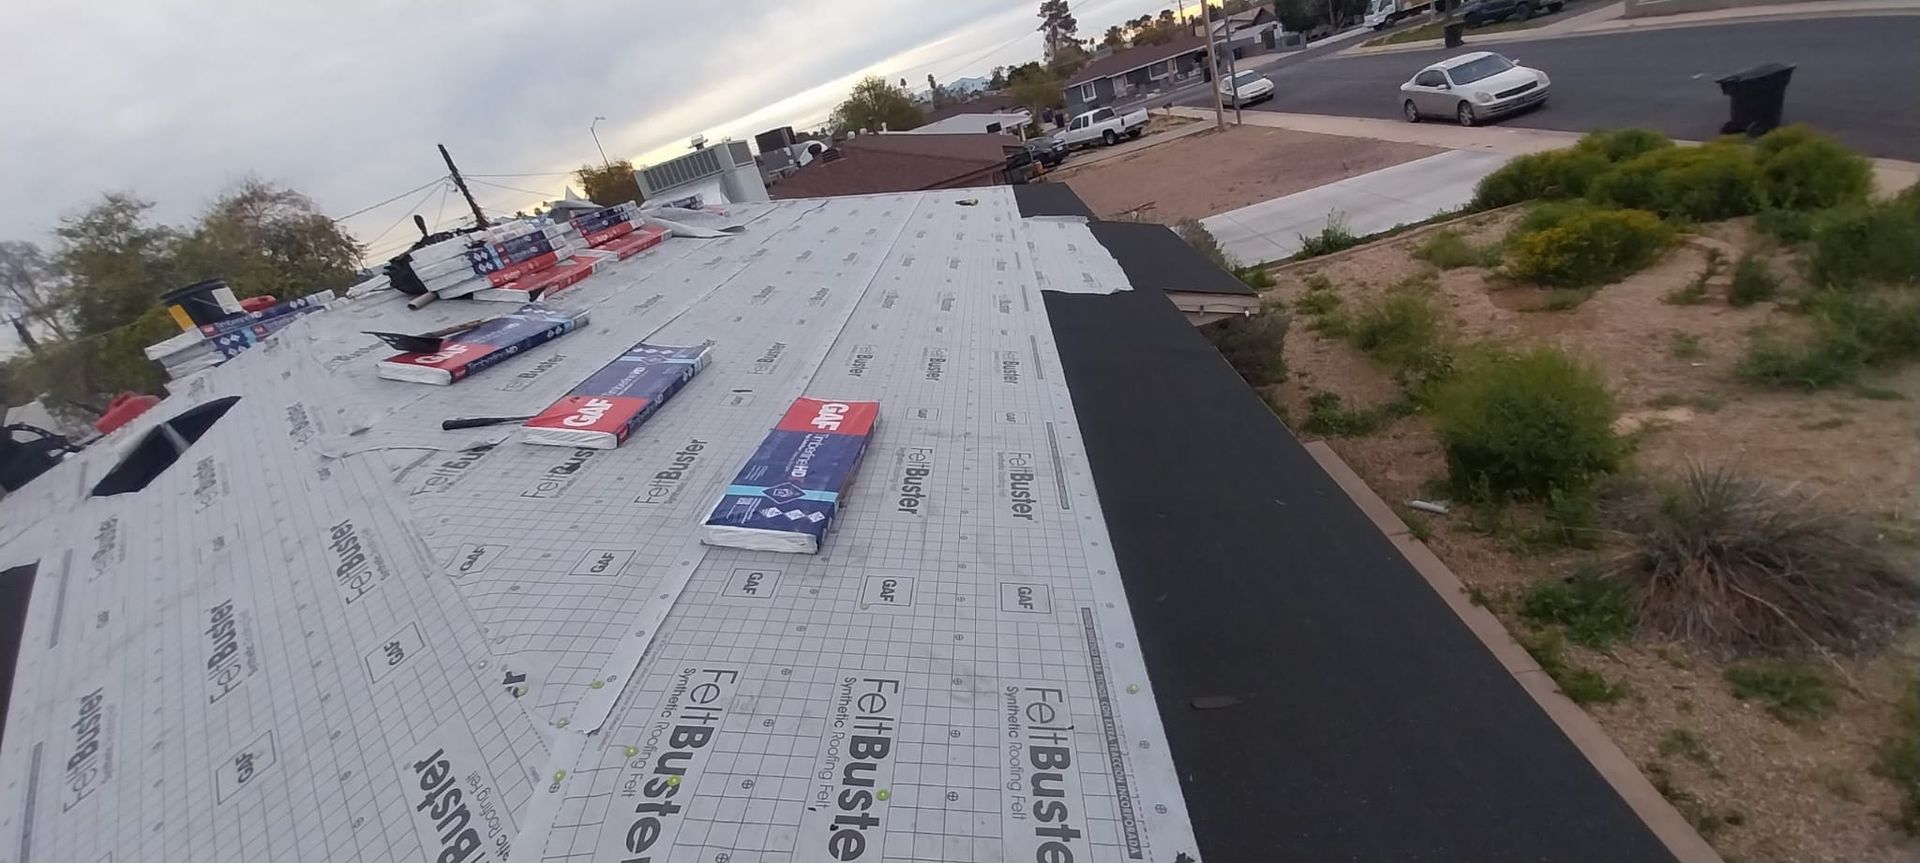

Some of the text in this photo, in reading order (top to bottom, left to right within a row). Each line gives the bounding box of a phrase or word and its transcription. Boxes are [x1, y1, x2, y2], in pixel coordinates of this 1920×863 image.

[415, 344, 469, 364] GAF
[563, 398, 614, 427] GAF
[811, 402, 850, 431] GAF
[633, 439, 708, 504] FeltBuster
[898, 447, 932, 515] FeltBuster
[1008, 452, 1037, 521] FeltBuster
[328, 519, 376, 605] FeltBuster
[460, 546, 486, 572] GAF
[590, 552, 615, 573] GAF
[741, 572, 763, 595] GAF
[879, 579, 897, 602] GAF
[1016, 586, 1033, 609] GAF
[204, 598, 243, 704] FeltBuster
[384, 641, 404, 666] GAF
[63, 687, 104, 813] FeltBuster
[621, 668, 696, 798] Synthetic Roofing Felt
[815, 676, 857, 808] Synthetic Roofing Felt
[1006, 686, 1027, 819] Synthetic Roofing Felt
[235, 753, 254, 783] GAF
[465, 770, 482, 794] Felt
[476, 787, 502, 839] Roofing
[1117, 785, 1140, 854] INCORPORADA
